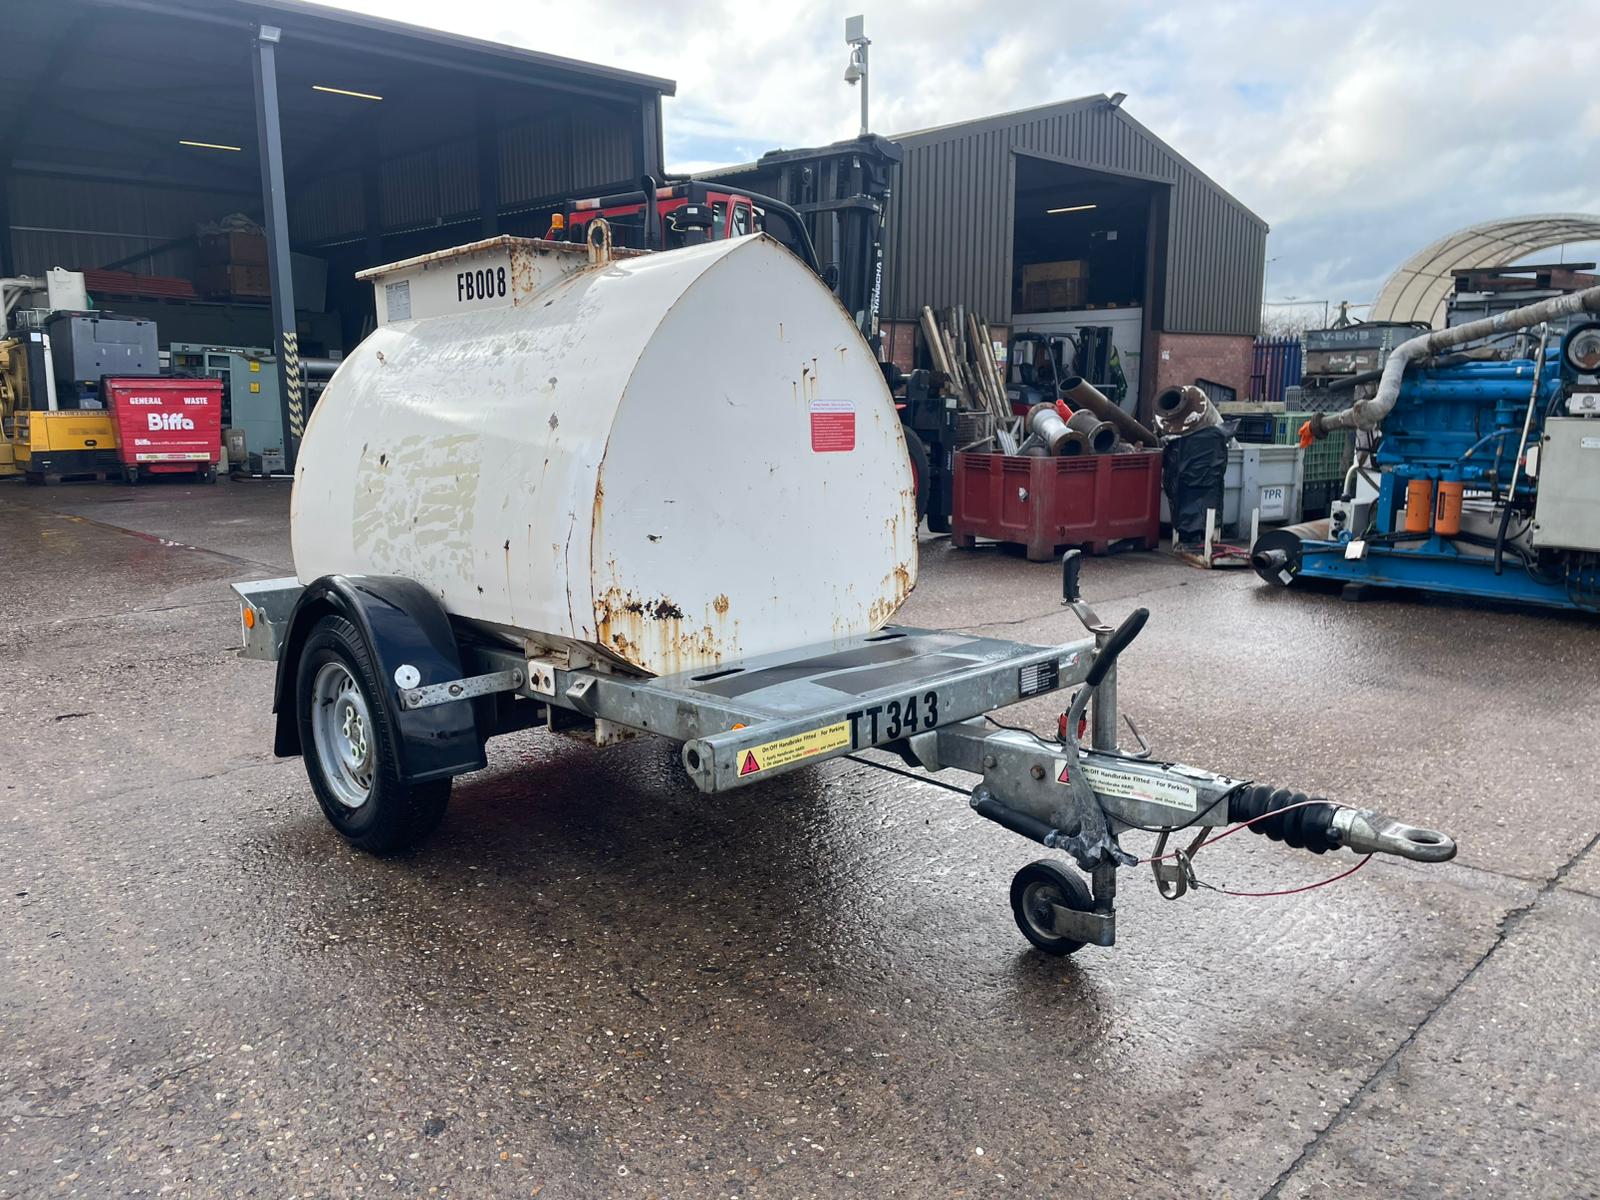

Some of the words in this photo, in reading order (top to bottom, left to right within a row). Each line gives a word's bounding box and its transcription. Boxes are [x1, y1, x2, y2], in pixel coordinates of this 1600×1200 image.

[457, 266, 506, 302] FB008
[129, 397, 162, 405] GENERAL
[183, 397, 208, 405] WASTE
[147, 413, 194, 431] Biffa
[1263, 488, 1282, 500] TPR
[846, 691, 938, 750] TT343
[779, 737, 802, 748] Handbrake
[803, 732, 817, 741] Fitted
[829, 725, 845, 734] Parking
[1100, 770, 1131, 781] Handbrake
[1133, 776, 1150, 784] Fitted
[1168, 782, 1190, 793] Parking
